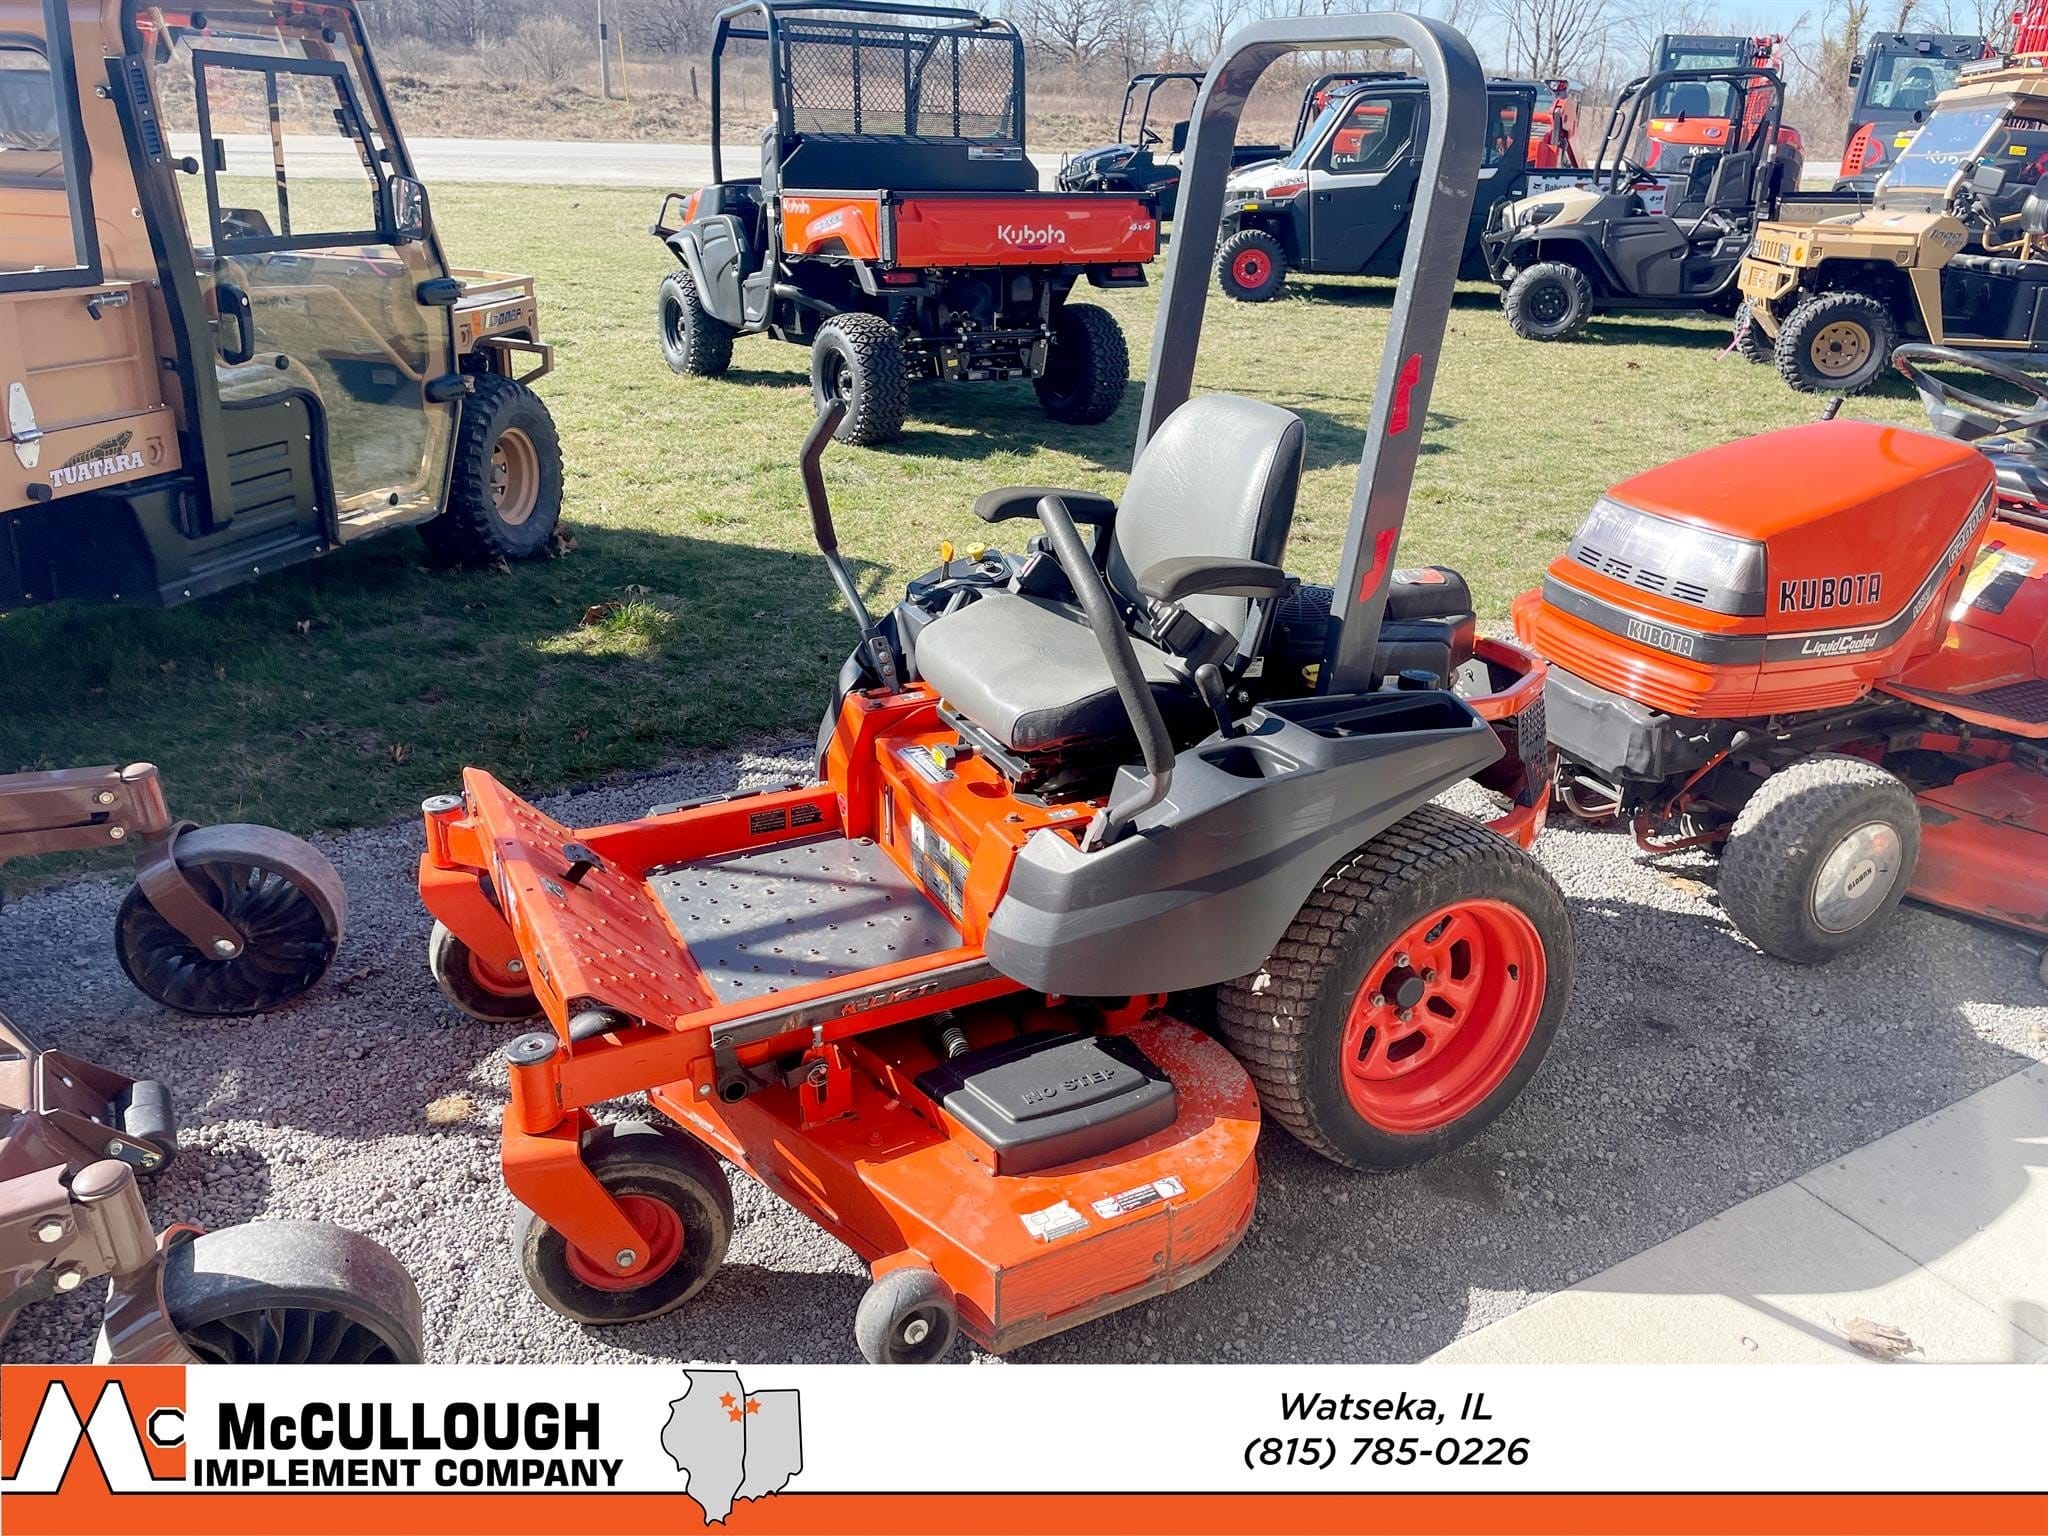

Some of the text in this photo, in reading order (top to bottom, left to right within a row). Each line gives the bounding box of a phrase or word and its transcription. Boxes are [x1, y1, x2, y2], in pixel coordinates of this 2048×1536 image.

[997, 224, 1066, 245] Kubota
[1129, 222, 1151, 232] 4x4
[49, 451, 145, 488] TUATARA
[1779, 573, 1882, 613] KUBOTA
[1627, 618, 1694, 656] KUBOTA
[1022, 1068, 1116, 1105] NO STEP
